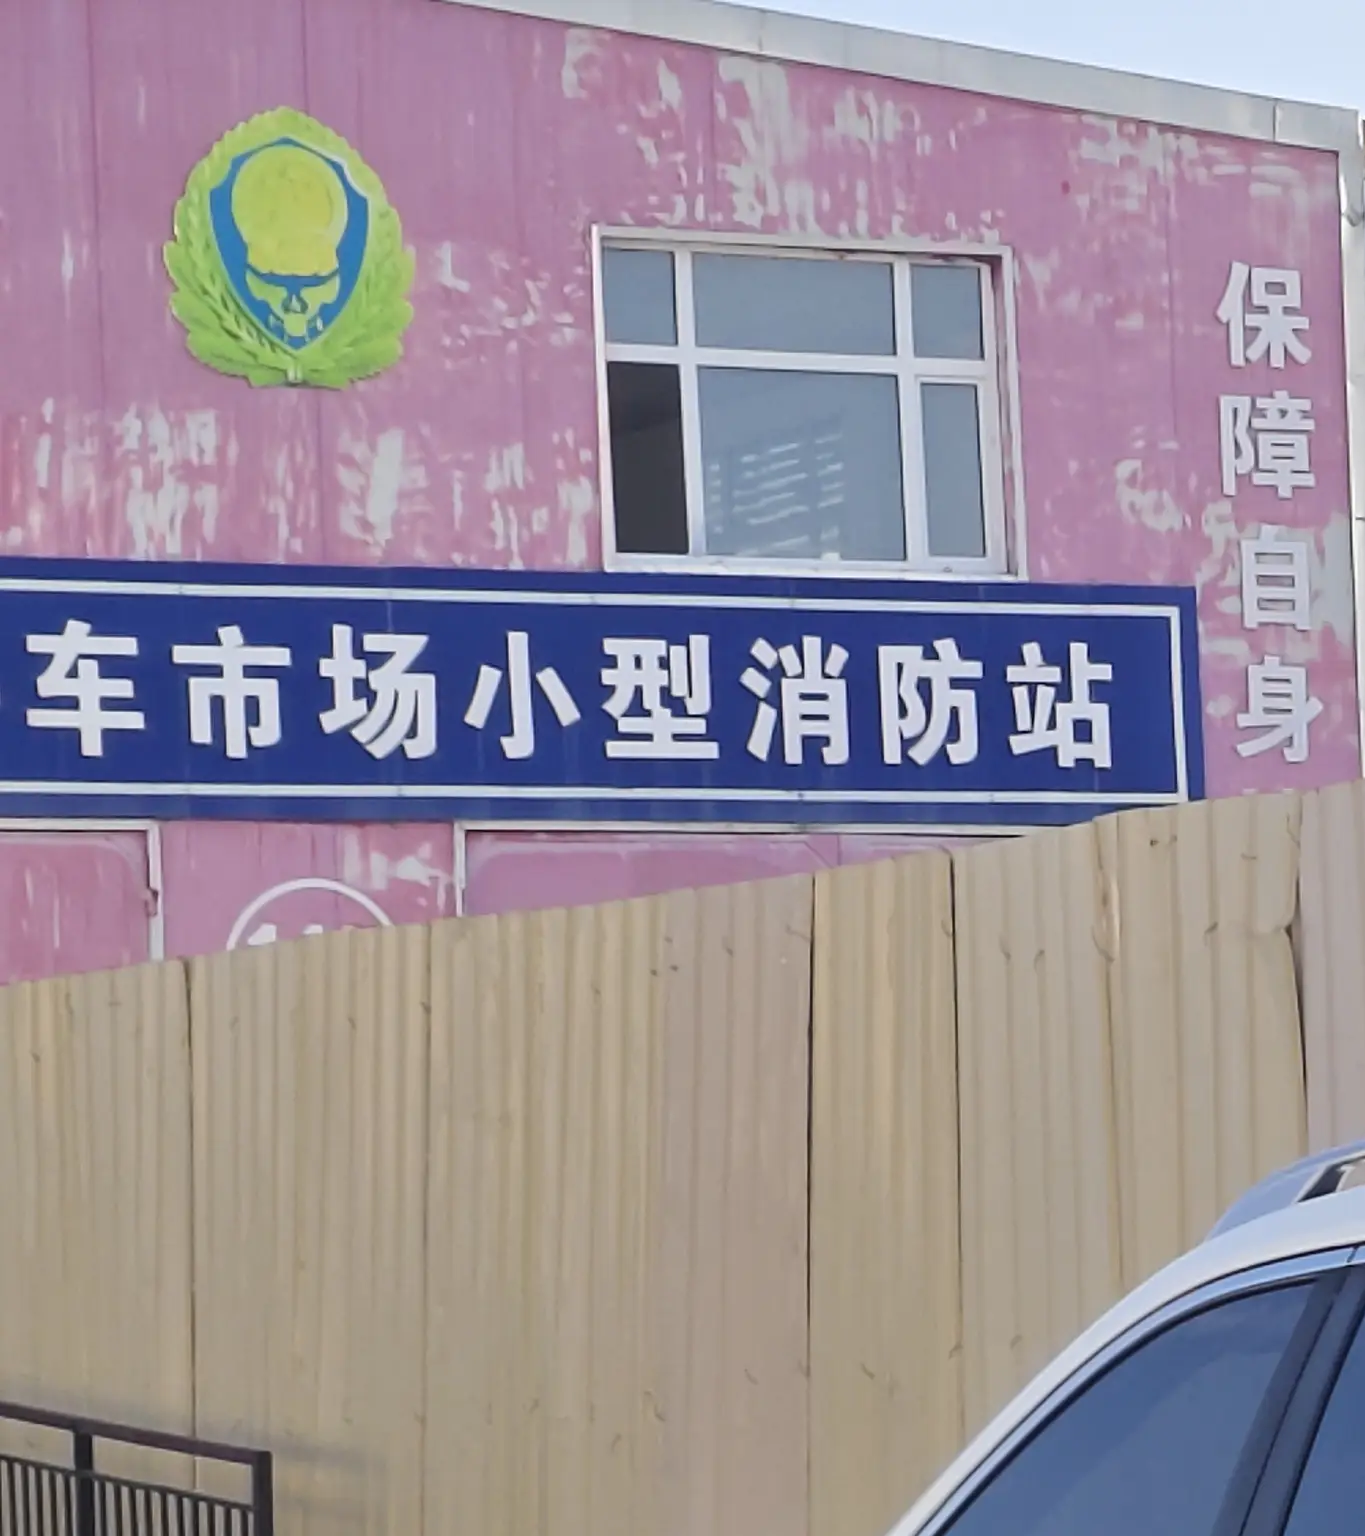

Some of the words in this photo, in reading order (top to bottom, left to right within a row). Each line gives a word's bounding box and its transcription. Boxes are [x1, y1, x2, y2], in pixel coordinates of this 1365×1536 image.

[1215, 260, 1324, 764] 保障自身
[25, 618, 1113, 768] 车市场小型消防站
